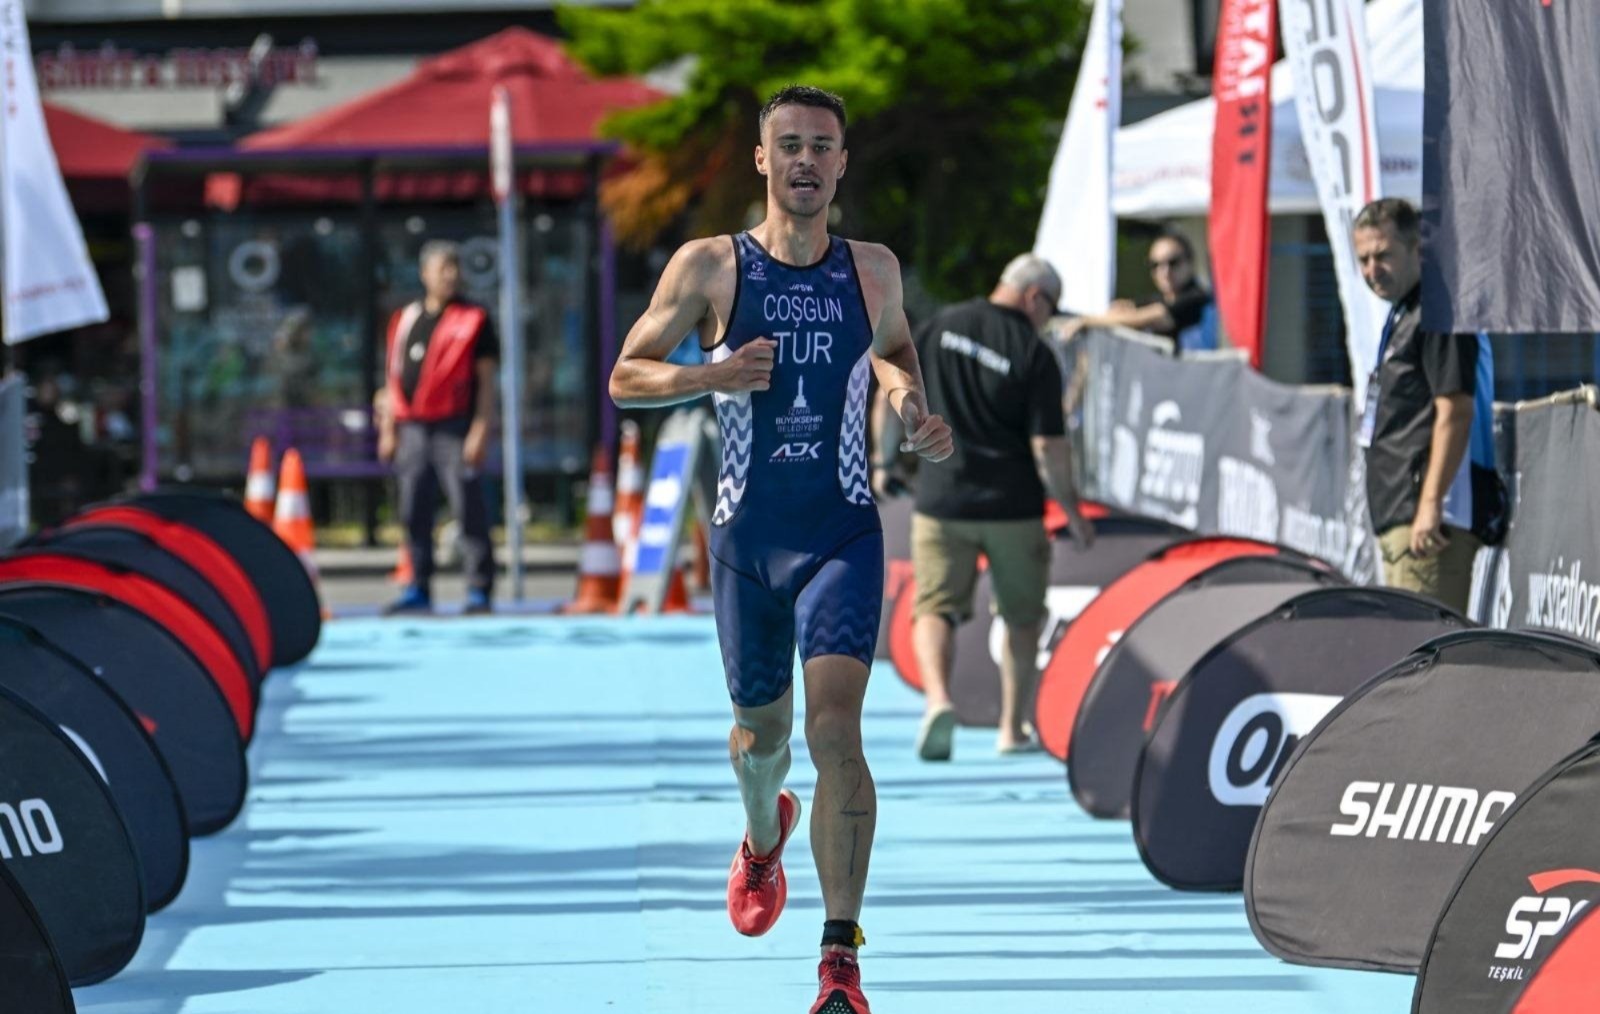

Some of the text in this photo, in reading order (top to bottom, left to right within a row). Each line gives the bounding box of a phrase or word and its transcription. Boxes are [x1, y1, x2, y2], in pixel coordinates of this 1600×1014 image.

[763, 294, 843, 328] COŞGUN
[773, 331, 833, 364] TUR
[770, 441, 823, 459] ADK
[1494, 896, 1590, 960] SP
[1488, 965, 1531, 982] TEŞKİL
